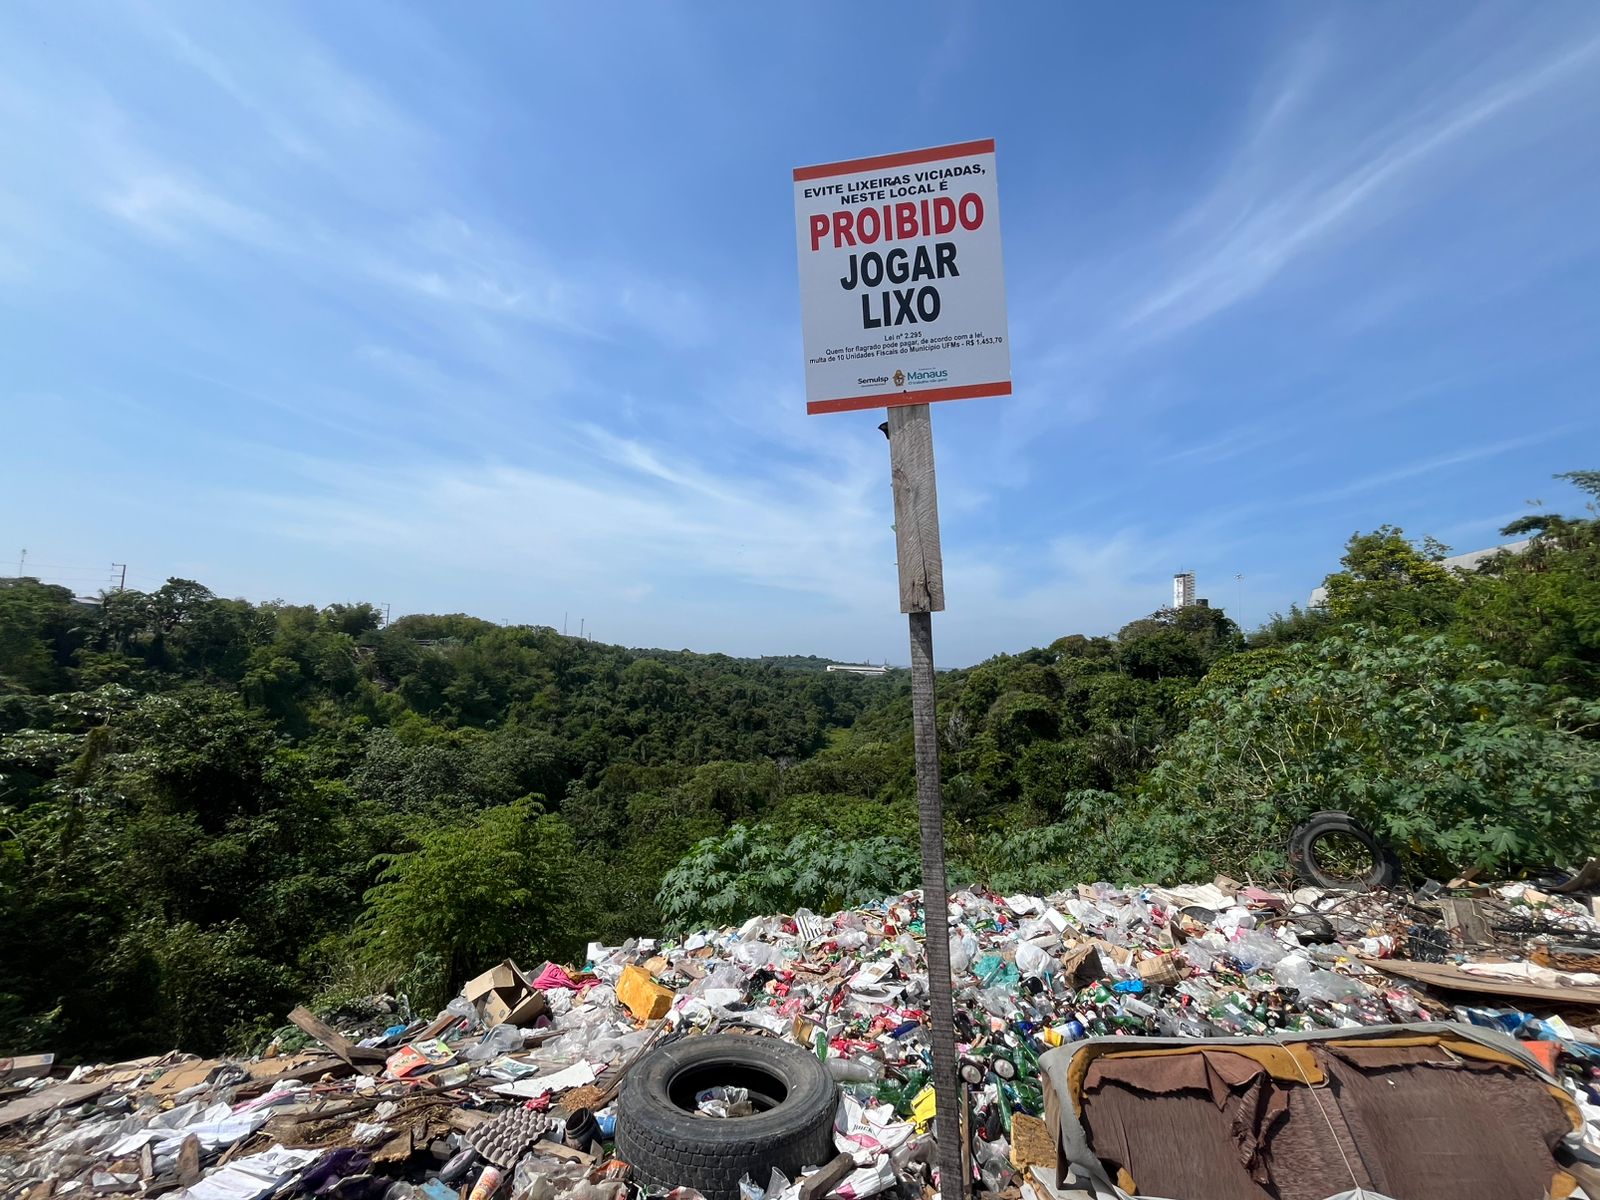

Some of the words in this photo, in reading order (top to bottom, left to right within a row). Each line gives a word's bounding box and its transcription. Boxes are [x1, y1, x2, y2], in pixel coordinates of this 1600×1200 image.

[804, 184, 844, 198] EVITE
[847, 174, 911, 192] LIXEIRAS
[914, 163, 986, 182] VICIADAS,
[841, 190, 886, 205] NESTE
[889, 184, 935, 198] LOCAL
[939, 179, 949, 191] É
[809, 192, 984, 251] PROIBIDO
[840, 242, 960, 290] JOGAR
[861, 285, 941, 329] LIXO
[845, 351, 875, 360] Unidades
[876, 348, 899, 357] Fiscais
[941, 340, 961, 350] UFMs
[855, 343, 881, 352] flagrado
[882, 341, 899, 351] pode
[930, 335, 953, 343] acordo
[907, 370, 949, 381] Manaus
